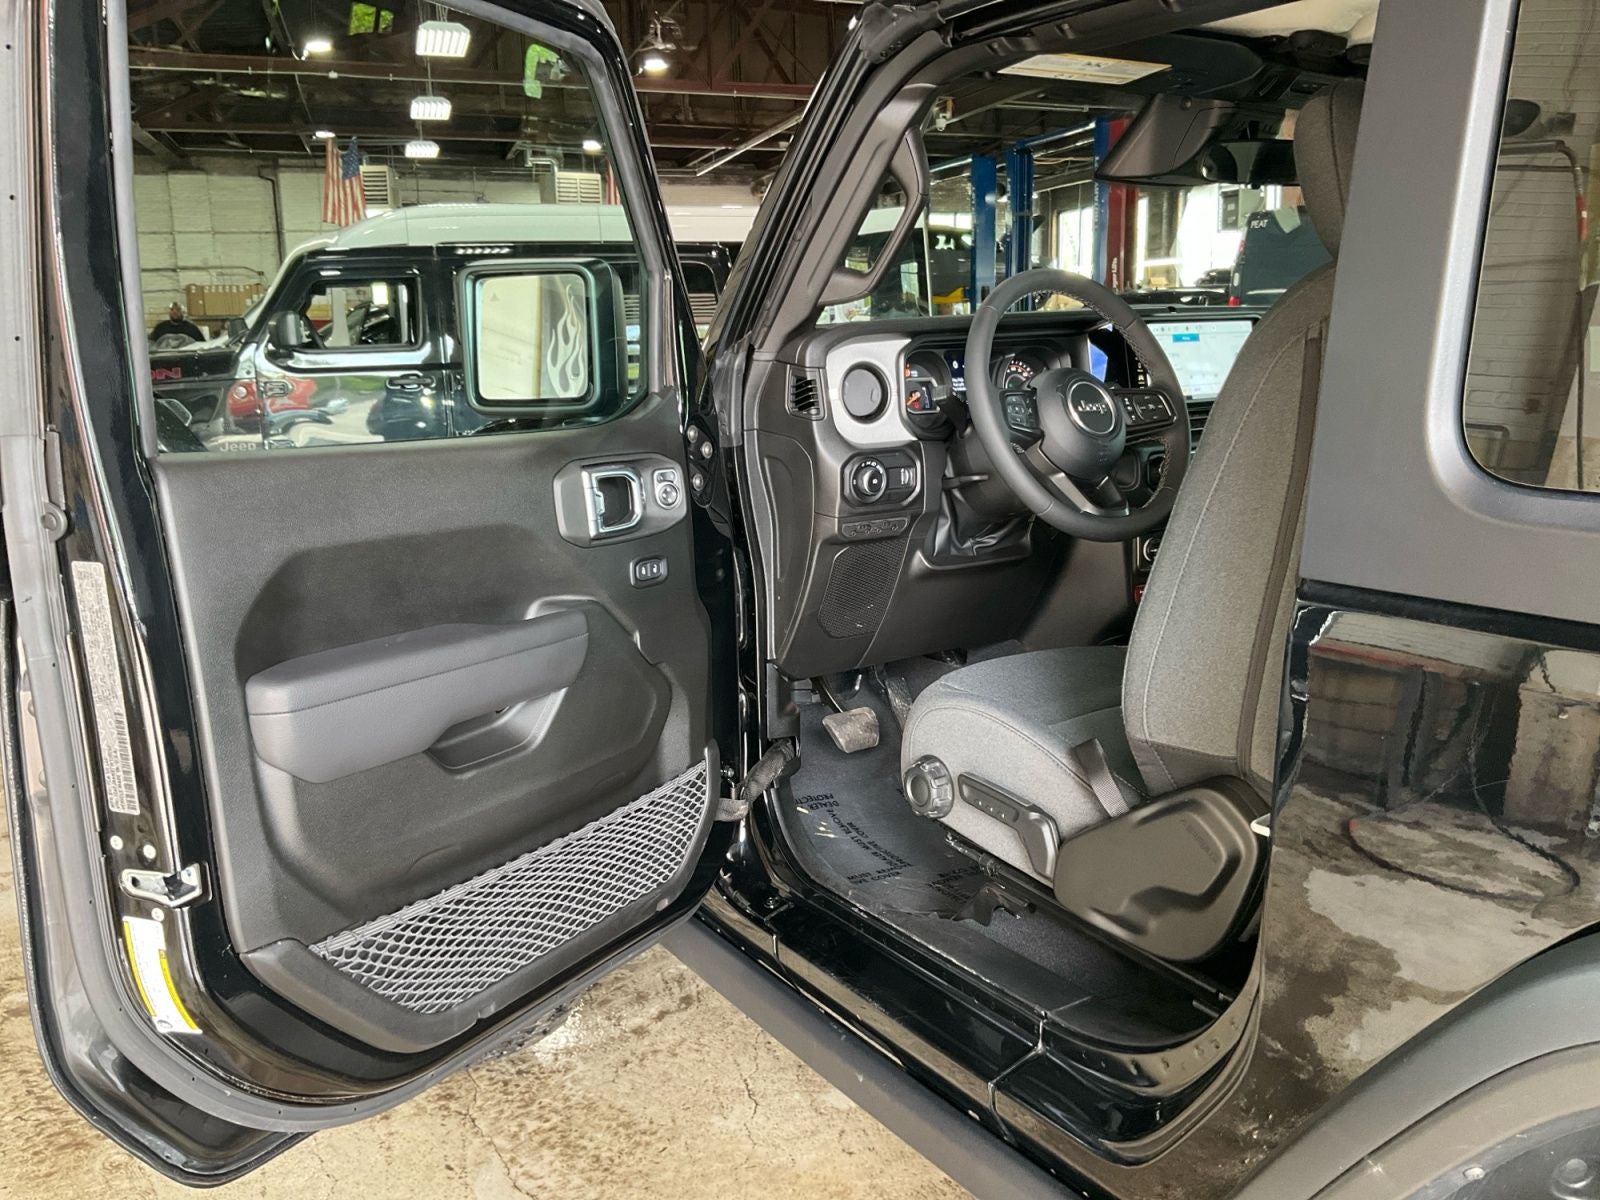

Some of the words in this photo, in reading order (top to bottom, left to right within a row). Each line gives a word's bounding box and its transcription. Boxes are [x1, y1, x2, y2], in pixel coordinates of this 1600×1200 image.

[1077, 400, 1107, 414] Jeep
[220, 441, 257, 452] Jeep
[808, 800, 840, 811] DEALER
[826, 809, 853, 835] REMOVE
[850, 835, 872, 850] MUST
